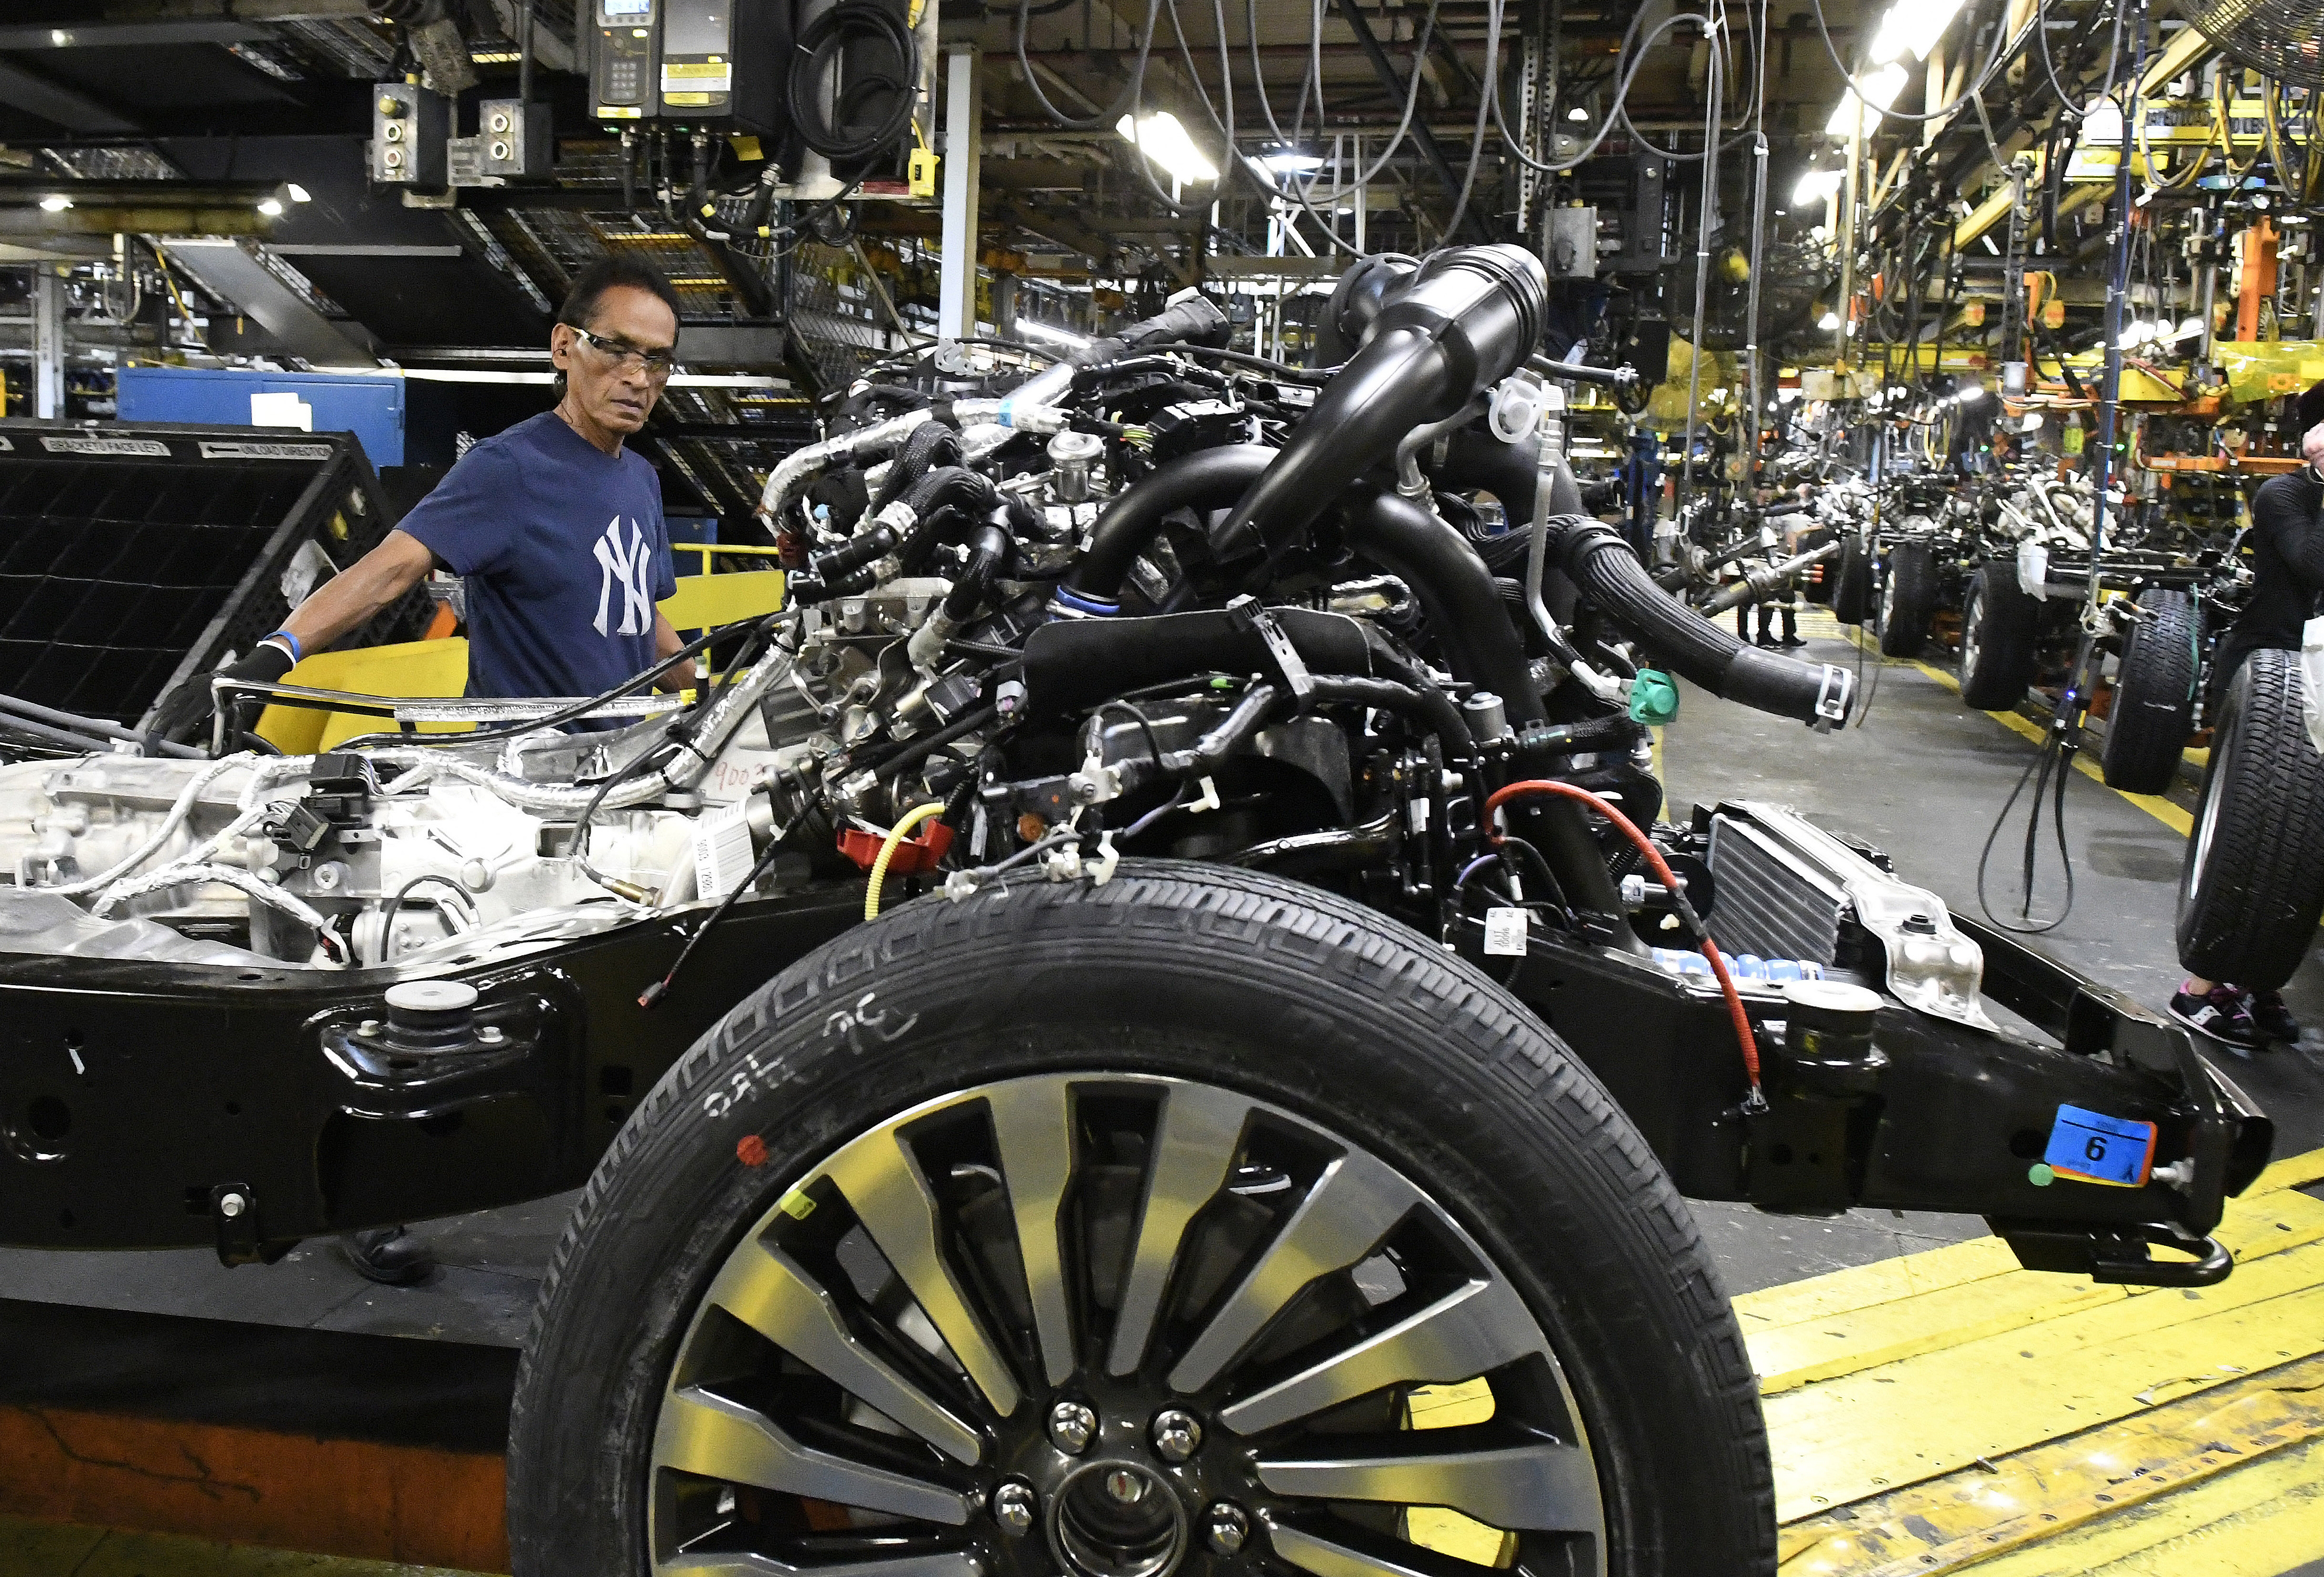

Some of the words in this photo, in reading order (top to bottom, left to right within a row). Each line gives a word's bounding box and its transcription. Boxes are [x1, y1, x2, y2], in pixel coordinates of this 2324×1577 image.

[137, 442, 164, 453] LEFT
[593, 515, 651, 638] NY
[2085, 1136, 2108, 1161] 6
